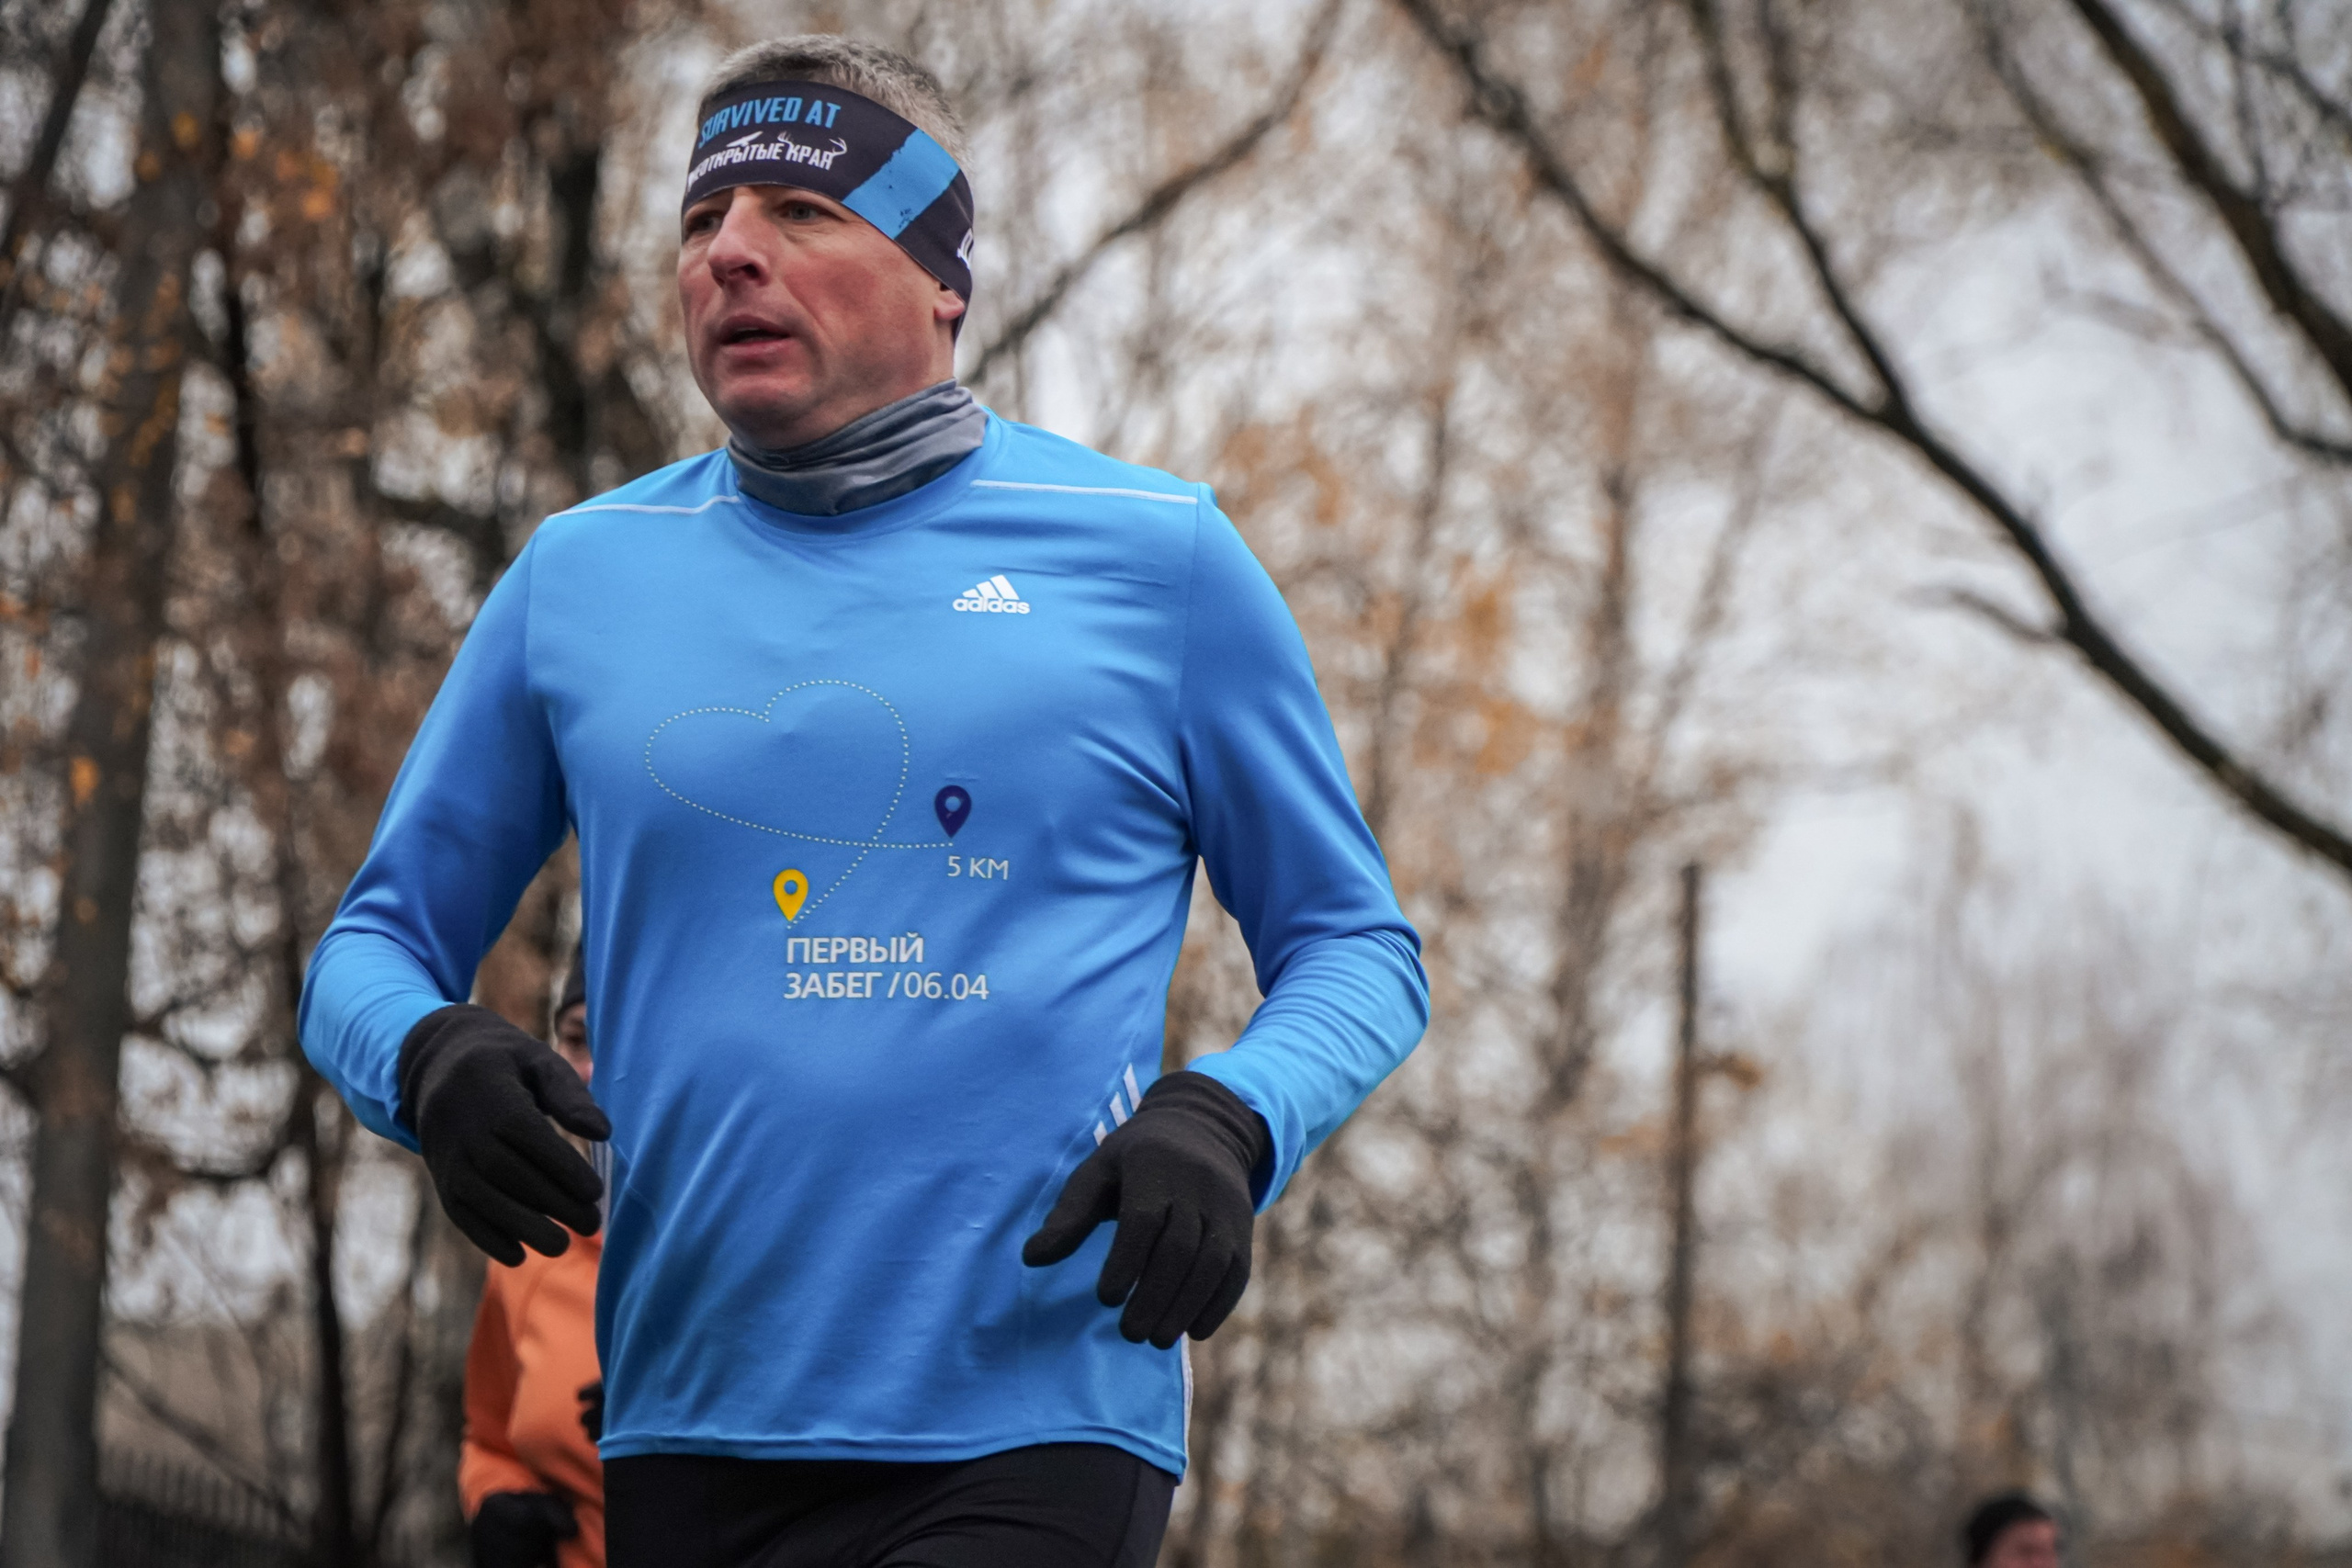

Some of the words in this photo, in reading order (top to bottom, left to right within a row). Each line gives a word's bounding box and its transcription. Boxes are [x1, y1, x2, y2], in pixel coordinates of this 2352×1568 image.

[698, 96, 803, 149] SURVIVED
[805, 99, 842, 129] AT
[687, 142, 785, 192] ЕОТКРЫТЫЕ
[784, 141, 840, 171] КРАЯ
[952, 595, 1031, 615] adidas
[947, 855, 961, 877] 5
[786, 931, 924, 964] ПЕРВЫЙ
[784, 972, 883, 999] ЗАБЕГ
